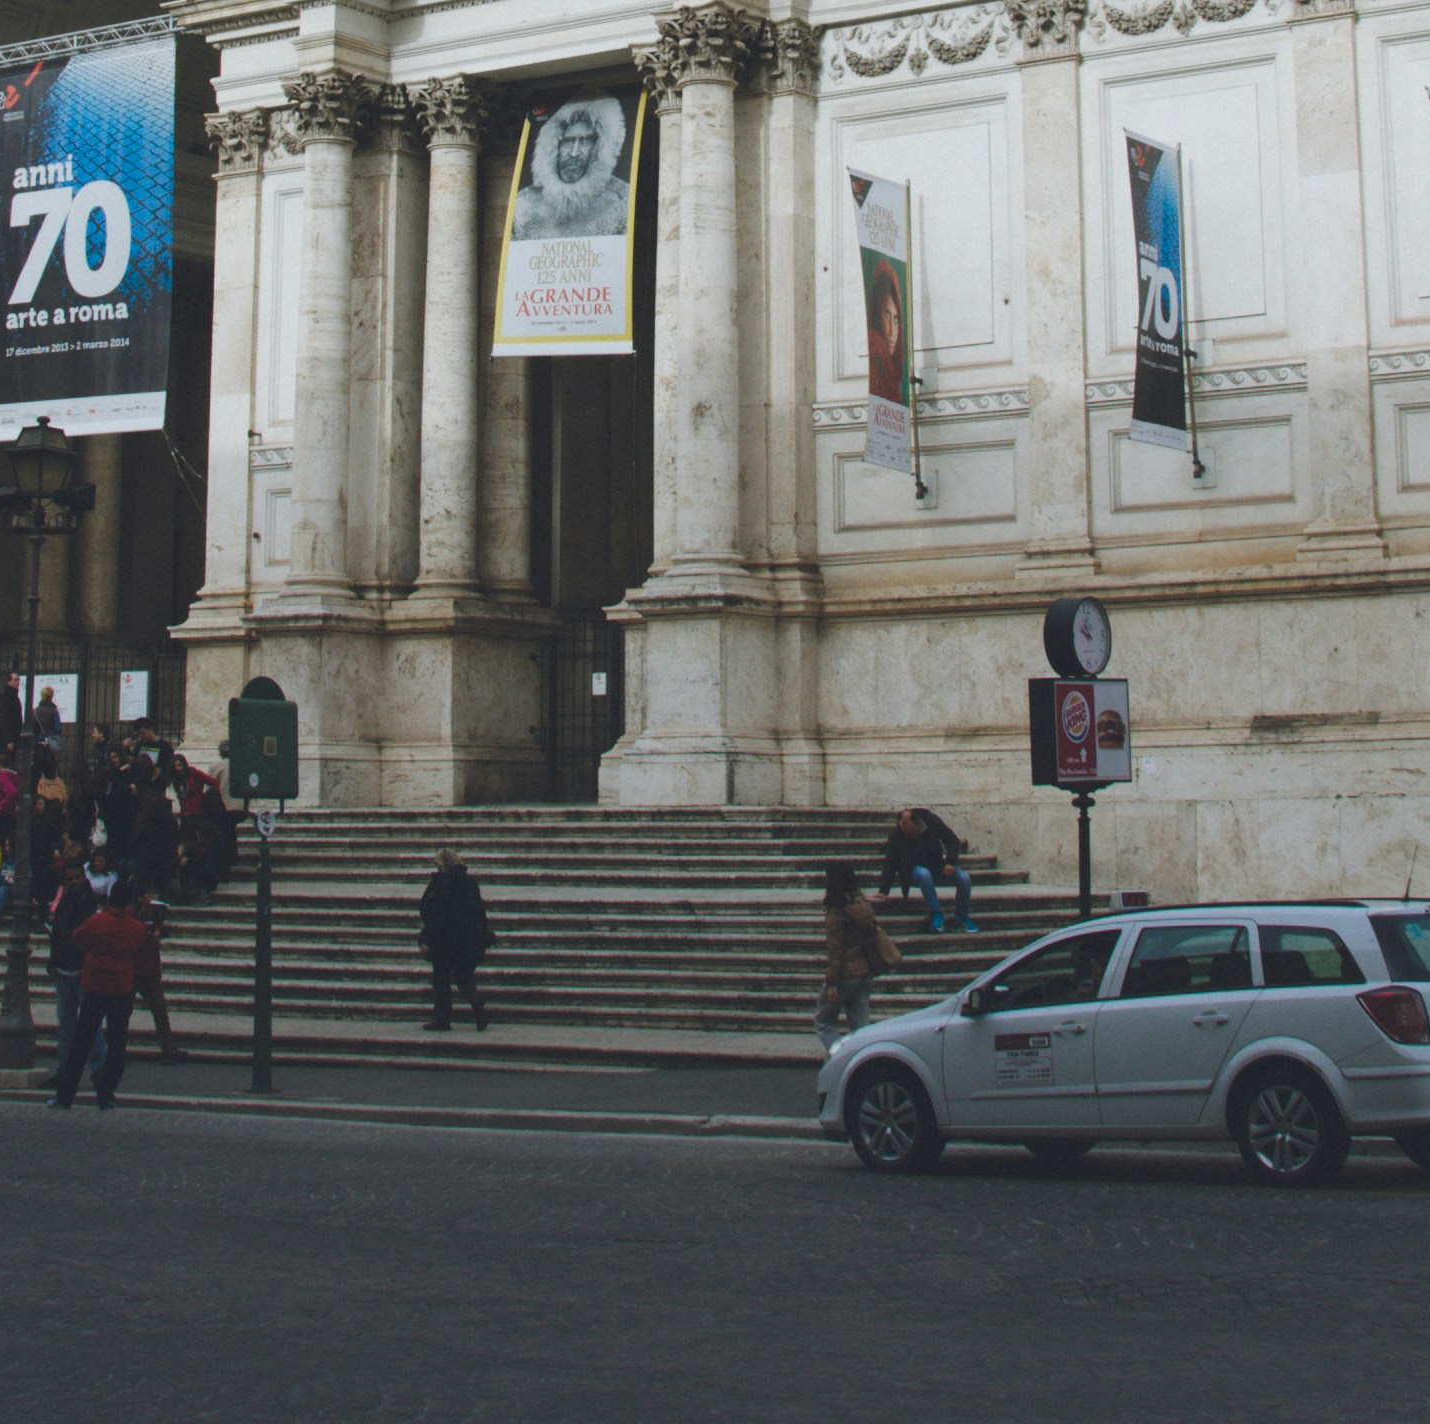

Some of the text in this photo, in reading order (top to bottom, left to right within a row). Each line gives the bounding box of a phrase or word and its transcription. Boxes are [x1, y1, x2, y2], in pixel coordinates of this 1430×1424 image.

[12, 154, 74, 190] anni
[7, 179, 132, 305] 70
[541, 240, 593, 256] NATIONAL
[1139, 240, 1158, 259] anni
[529, 253, 604, 270] GEOGRAPHIC
[537, 269, 592, 284] 125 ANNI
[530, 287, 611, 304] GRANDE
[1139, 260, 1179, 340] 70
[5, 301, 129, 330] arte a roma
[516, 301, 613, 317] AVVENTURA
[15, 343, 50, 357] dicembre
[51, 342, 69, 354] 2013
[83, 339, 109, 351] marzo
[110, 337, 130, 349] 2014
[1155, 340, 1179, 357] roma
[1067, 709, 1087, 730] KING
